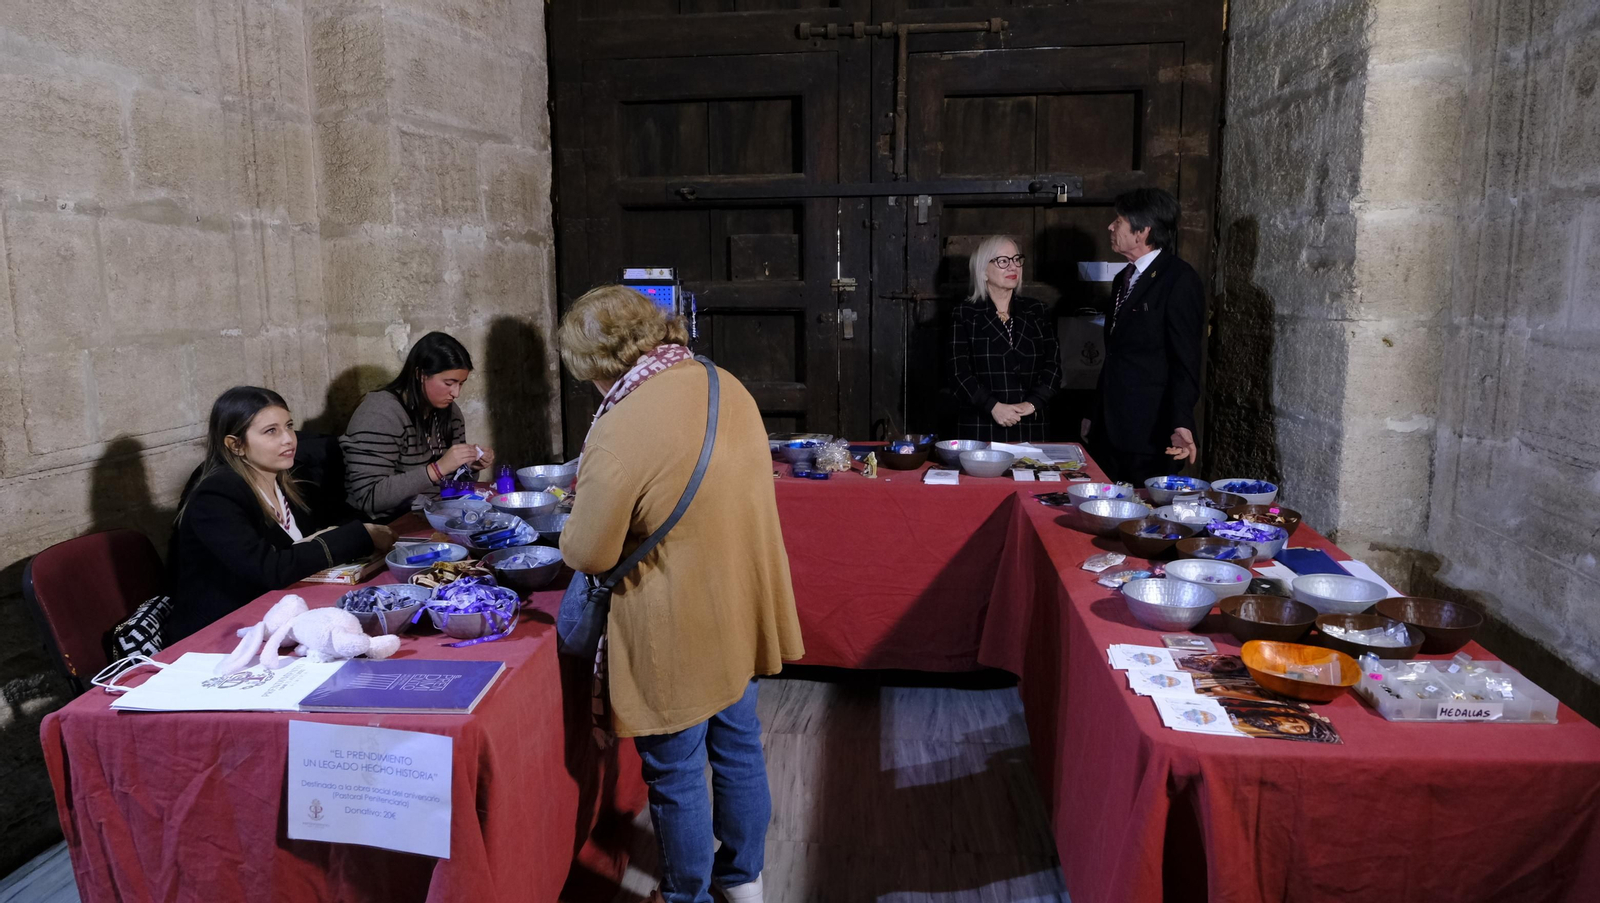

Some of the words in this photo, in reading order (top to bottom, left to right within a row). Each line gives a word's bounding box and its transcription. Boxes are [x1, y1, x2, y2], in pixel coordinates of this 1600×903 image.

[1439, 707, 1491, 718] MEDALLAS
[346, 750, 413, 766] PRENDIMIENTO
[303, 758, 317, 767] UN
[318, 760, 359, 772] LEGADO
[361, 763, 394, 776] HECHO
[301, 779, 337, 790] Destinado
[345, 783, 351, 791] la
[353, 784, 371, 792] obra
[372, 785, 391, 796] social
[392, 788, 402, 797] del
[404, 791, 440, 803] aniversario
[332, 791, 363, 801] (Pastoral
[364, 793, 410, 809] Penitenciaria)
[344, 806, 382, 818] Donativo:
[383, 810, 397, 820] 20€
